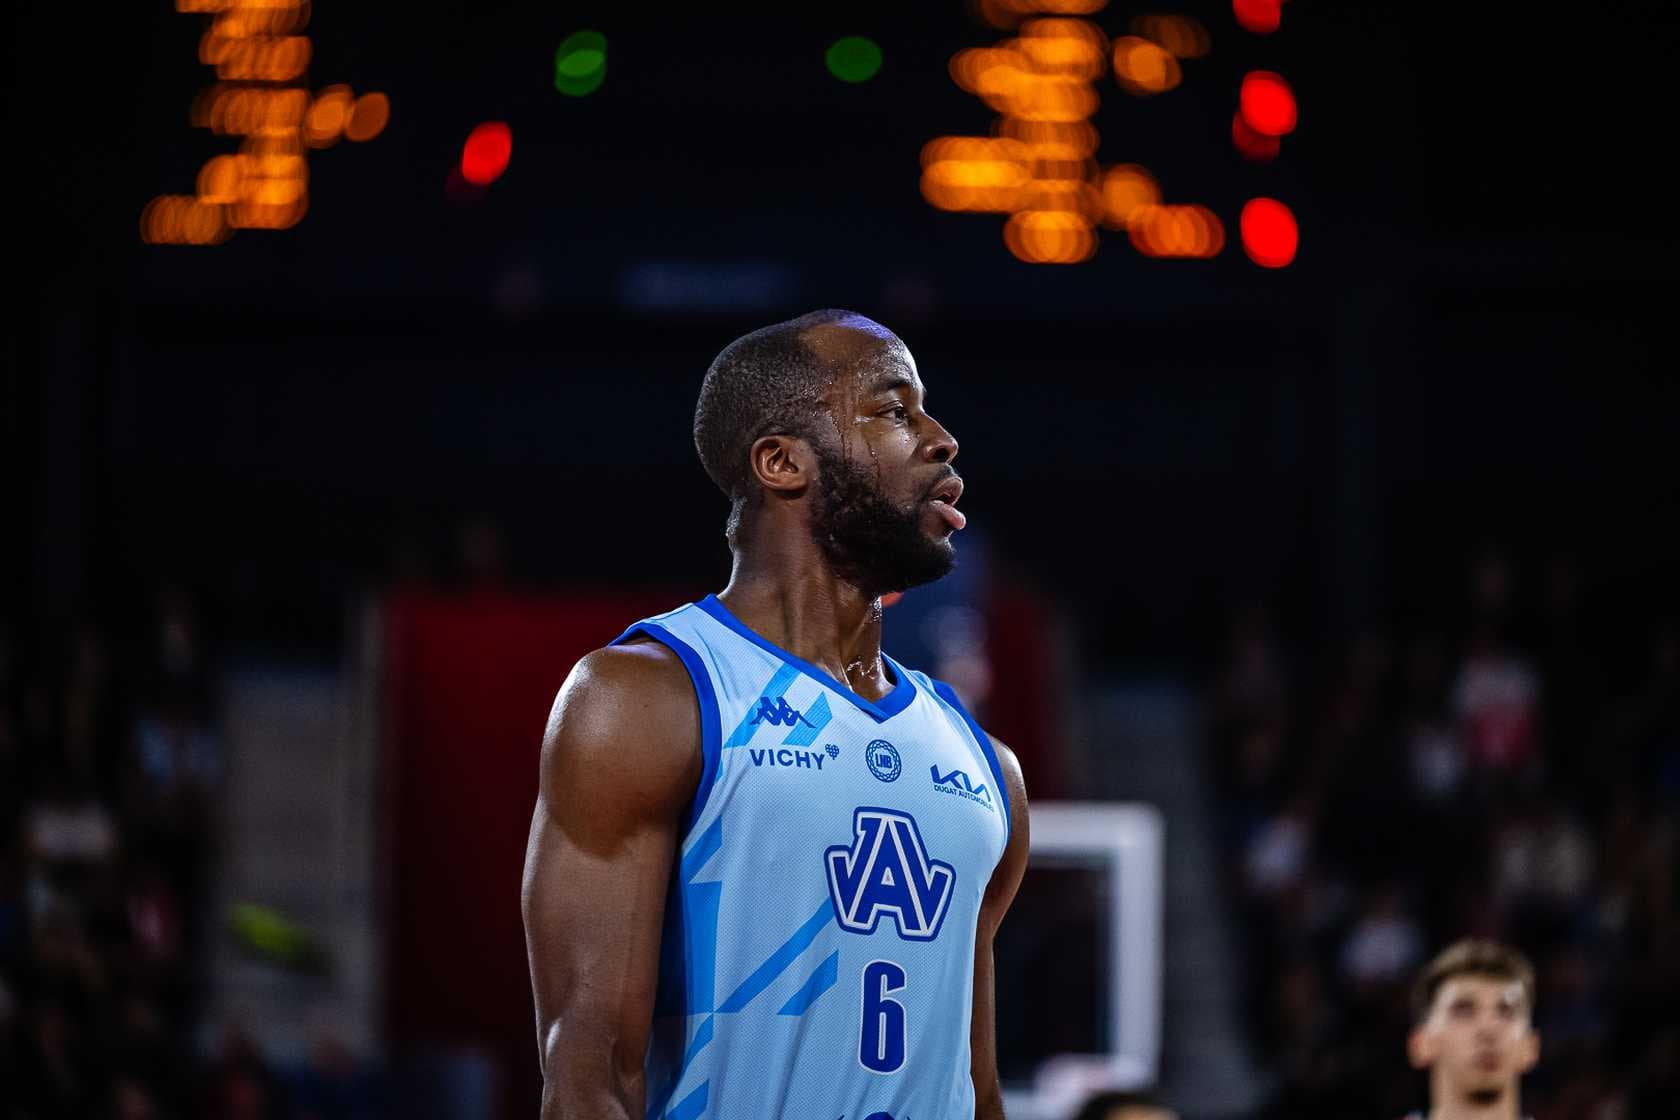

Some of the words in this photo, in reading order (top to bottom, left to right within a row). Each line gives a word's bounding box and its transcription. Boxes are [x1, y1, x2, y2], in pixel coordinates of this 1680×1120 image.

[749, 749, 825, 770] VICHY
[930, 764, 991, 802] KIA
[858, 959, 907, 1075] 6
